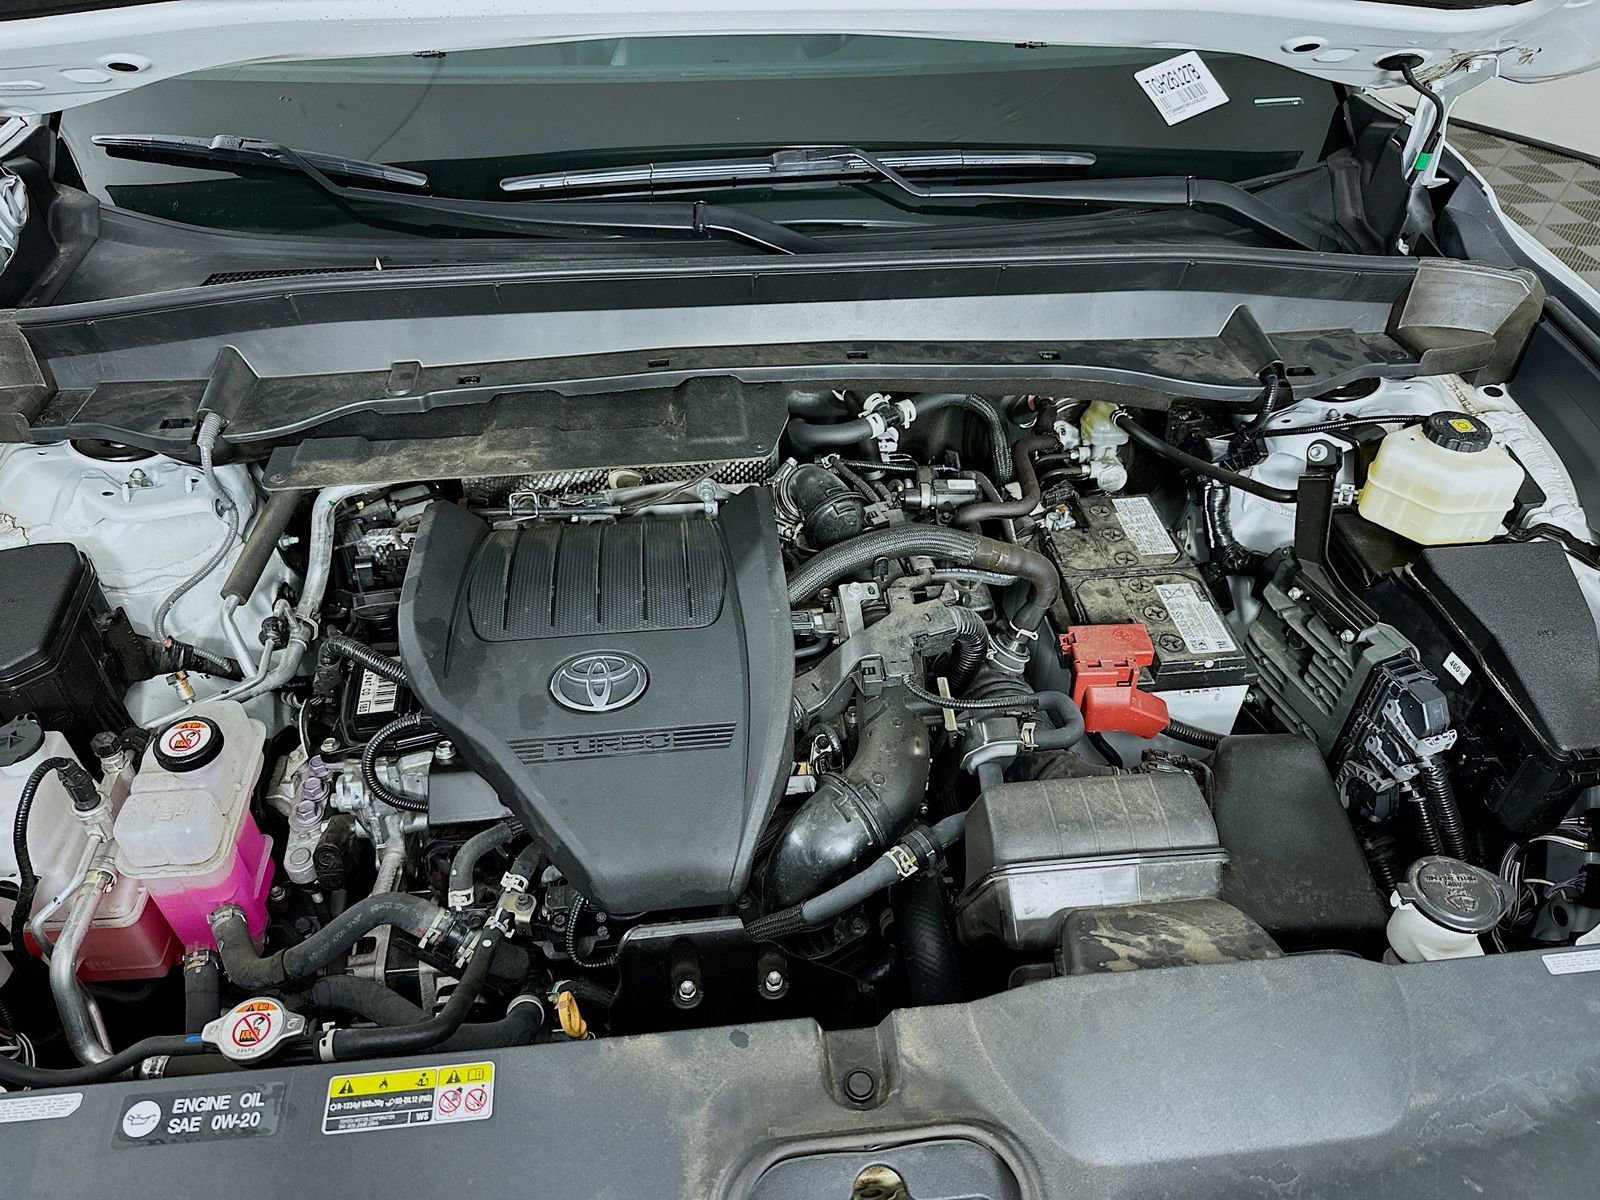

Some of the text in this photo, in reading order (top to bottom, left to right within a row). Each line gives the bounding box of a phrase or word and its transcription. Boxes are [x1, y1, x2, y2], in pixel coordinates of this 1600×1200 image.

[1449, 660, 1461, 673] 460
[547, 732, 671, 757] TURBO
[171, 1092, 265, 1115] ENGINE OIL
[167, 1111, 261, 1134] SAE 0W-20
[416, 1111, 430, 1122] WS
